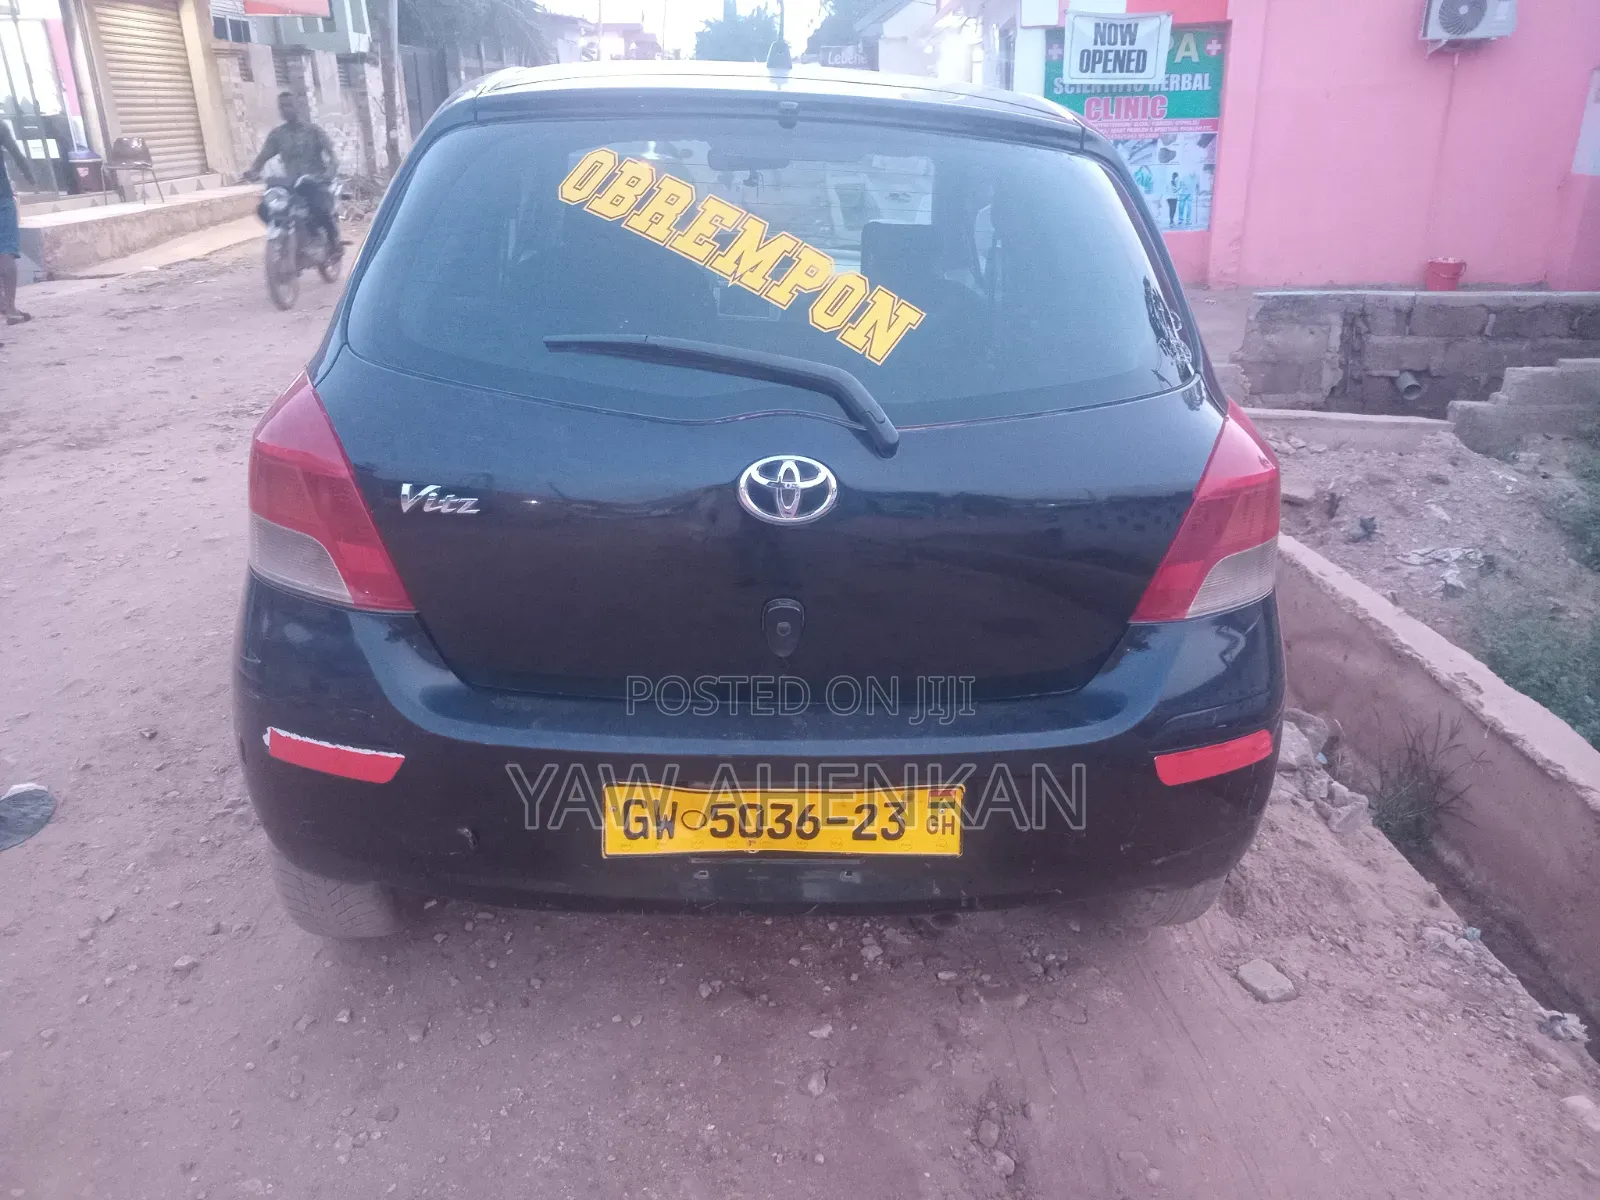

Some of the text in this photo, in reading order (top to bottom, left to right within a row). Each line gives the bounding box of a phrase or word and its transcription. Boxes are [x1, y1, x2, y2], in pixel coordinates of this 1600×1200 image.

[1093, 22, 1139, 47] NOW
[1079, 49, 1148, 74] OPENED
[1084, 95, 1168, 121] CLINIC
[558, 147, 926, 366] OBREMPON
[401, 483, 480, 513] Vitz
[623, 798, 908, 841] GW 5036-23
[926, 814, 956, 836] GH
